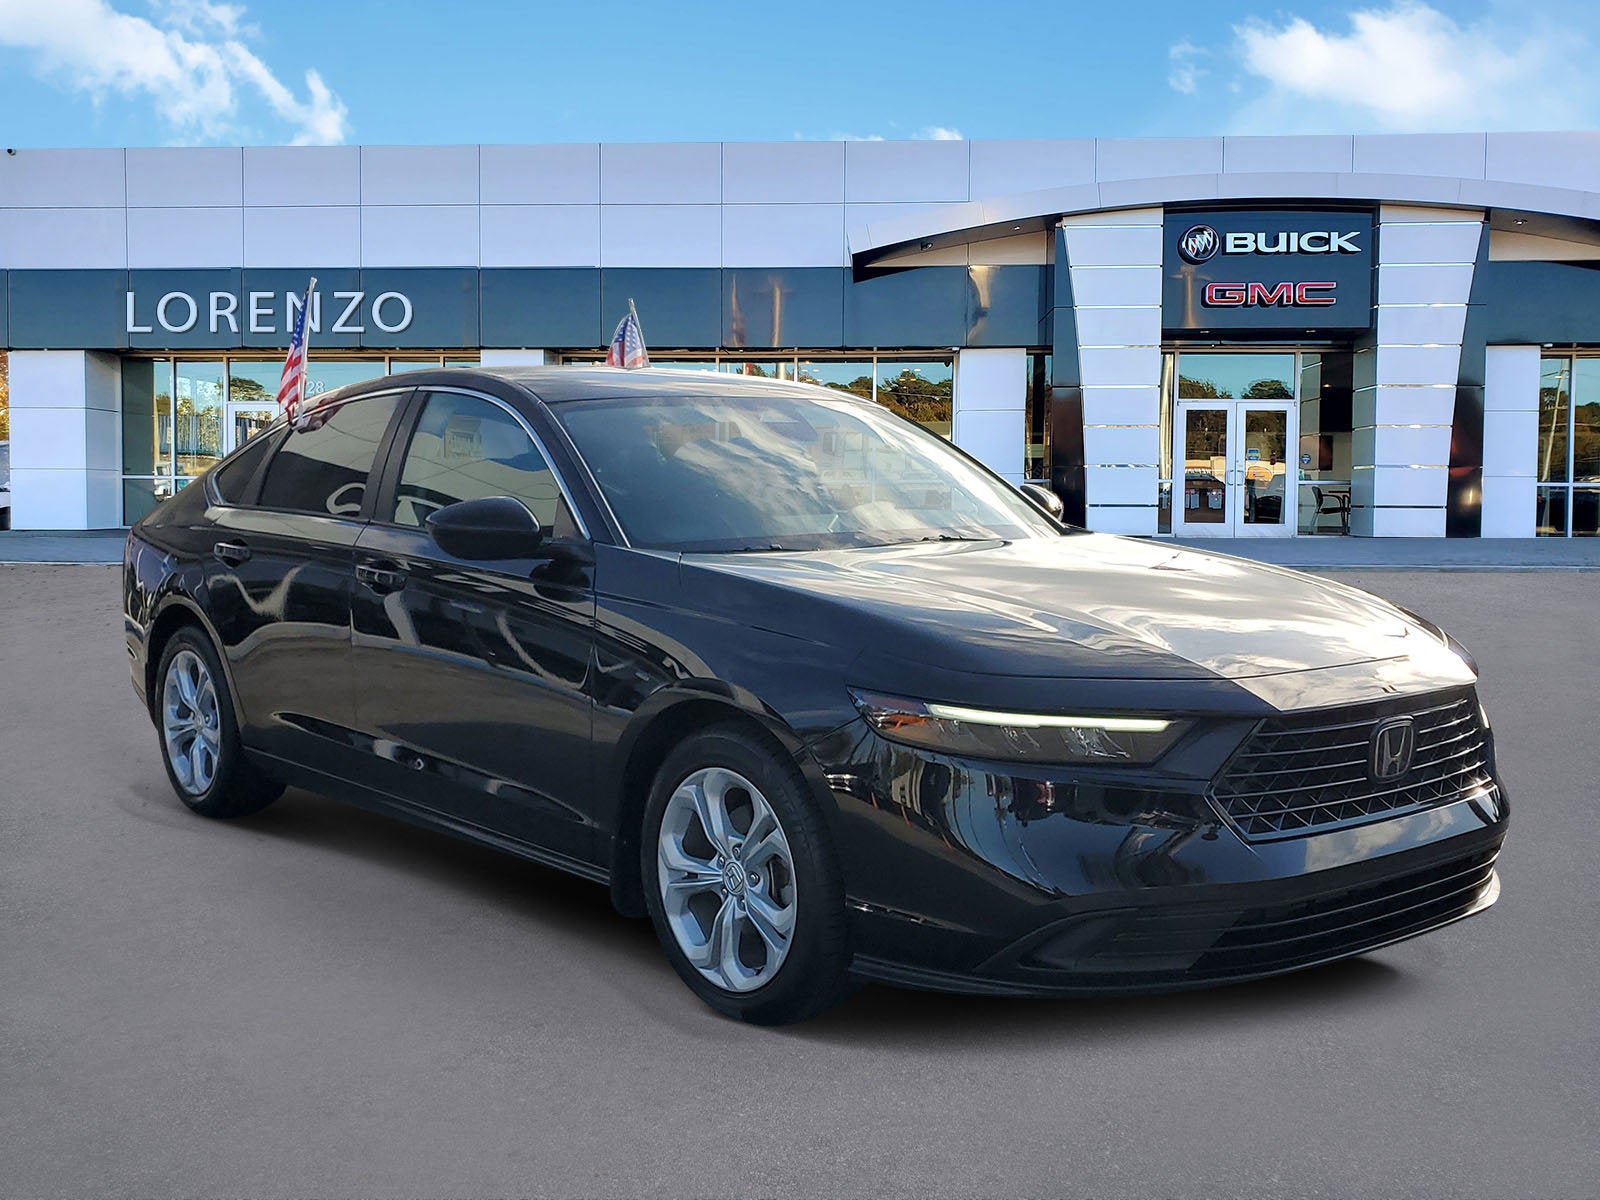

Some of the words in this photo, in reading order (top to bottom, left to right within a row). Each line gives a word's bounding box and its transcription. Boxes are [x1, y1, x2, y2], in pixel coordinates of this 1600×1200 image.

[1225, 231, 1362, 253] BUICK
[1205, 281, 1337, 305] GMC
[126, 291, 413, 333] LORENZO
